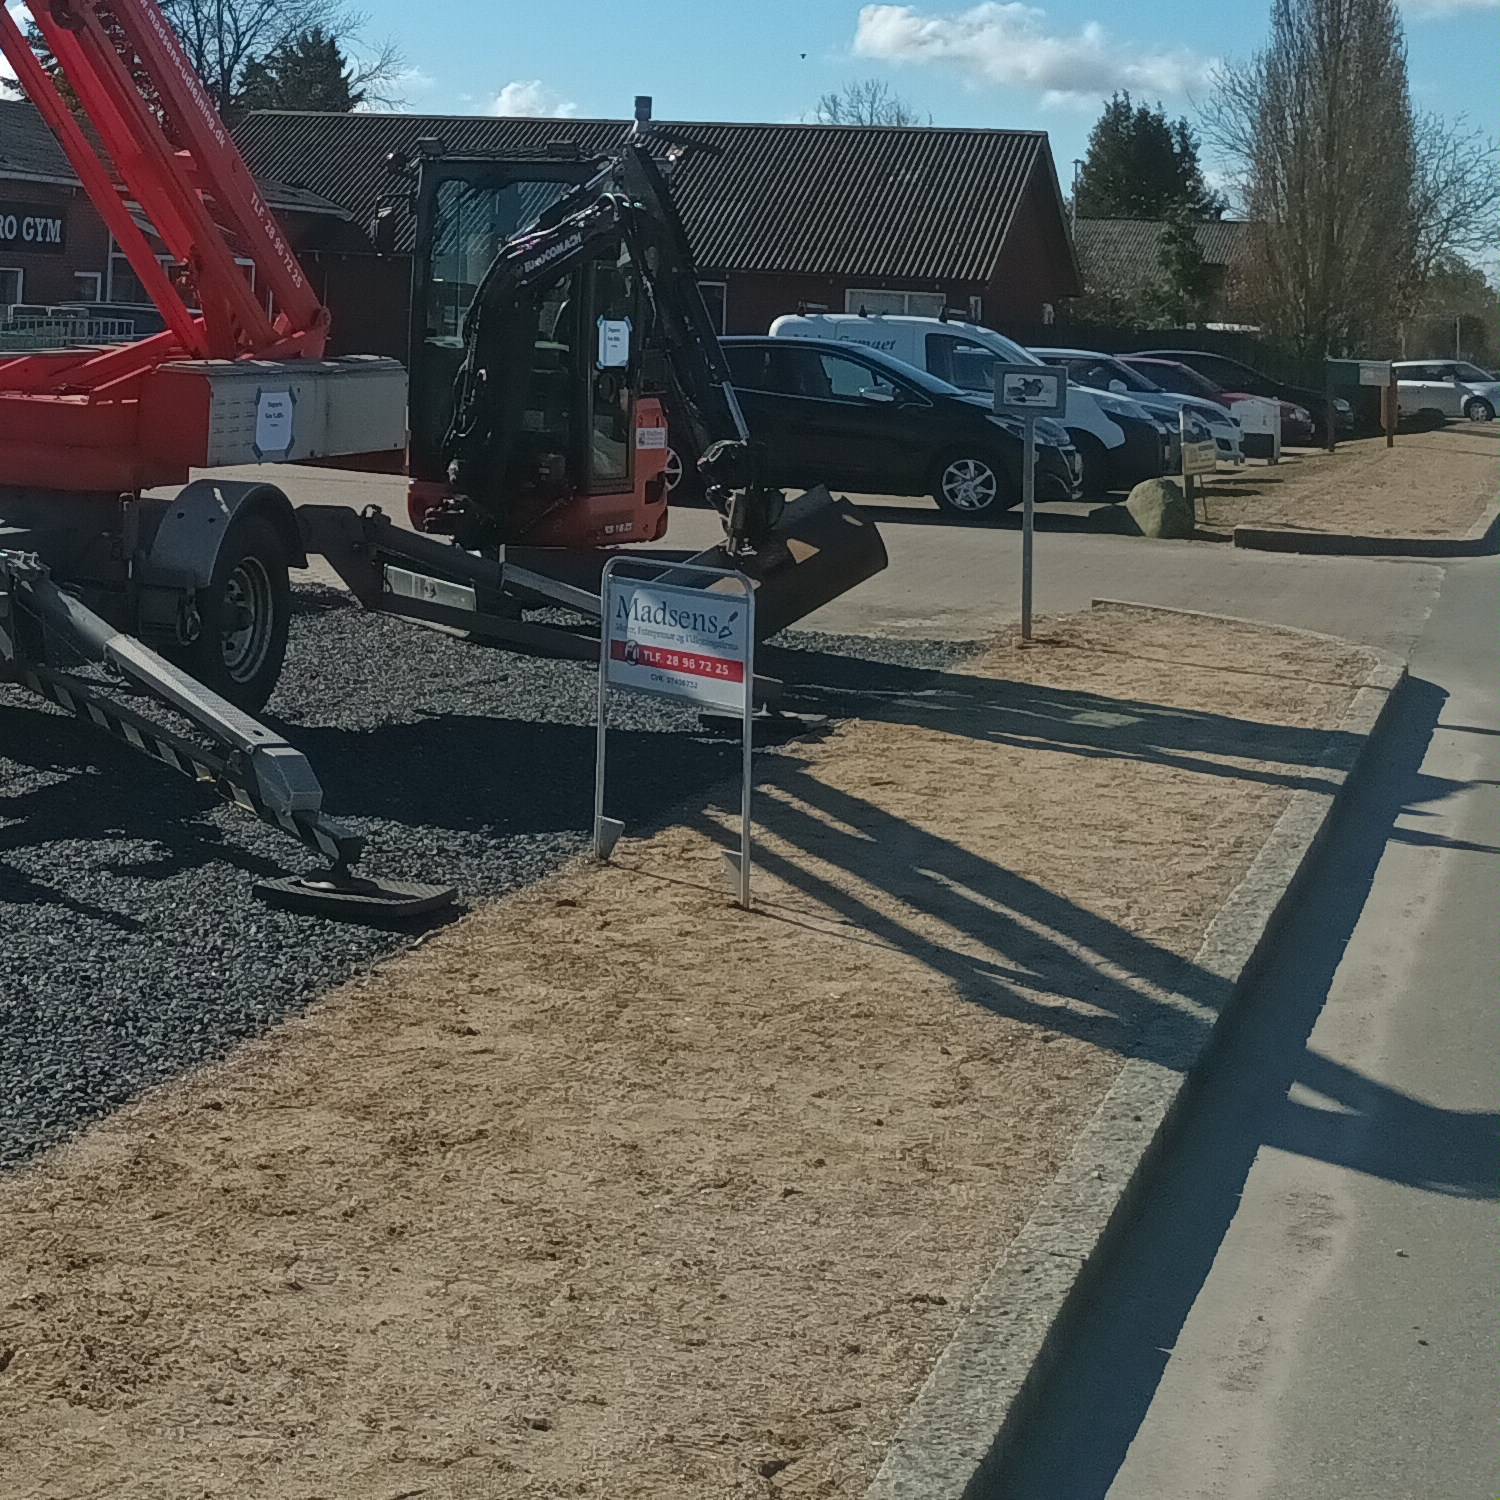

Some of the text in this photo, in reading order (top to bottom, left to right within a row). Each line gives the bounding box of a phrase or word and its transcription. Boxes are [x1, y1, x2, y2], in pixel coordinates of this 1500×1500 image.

[22, 216, 62, 243] GYM
[265, 219, 275, 239] 28
[274, 237, 284, 256] 96
[284, 253, 293, 273] 72
[292, 269, 302, 288] 25
[616, 595, 718, 634] Madsens
[666, 655, 679, 666] 28
[699, 660, 712, 672] 72
[715, 663, 729, 675] 25
